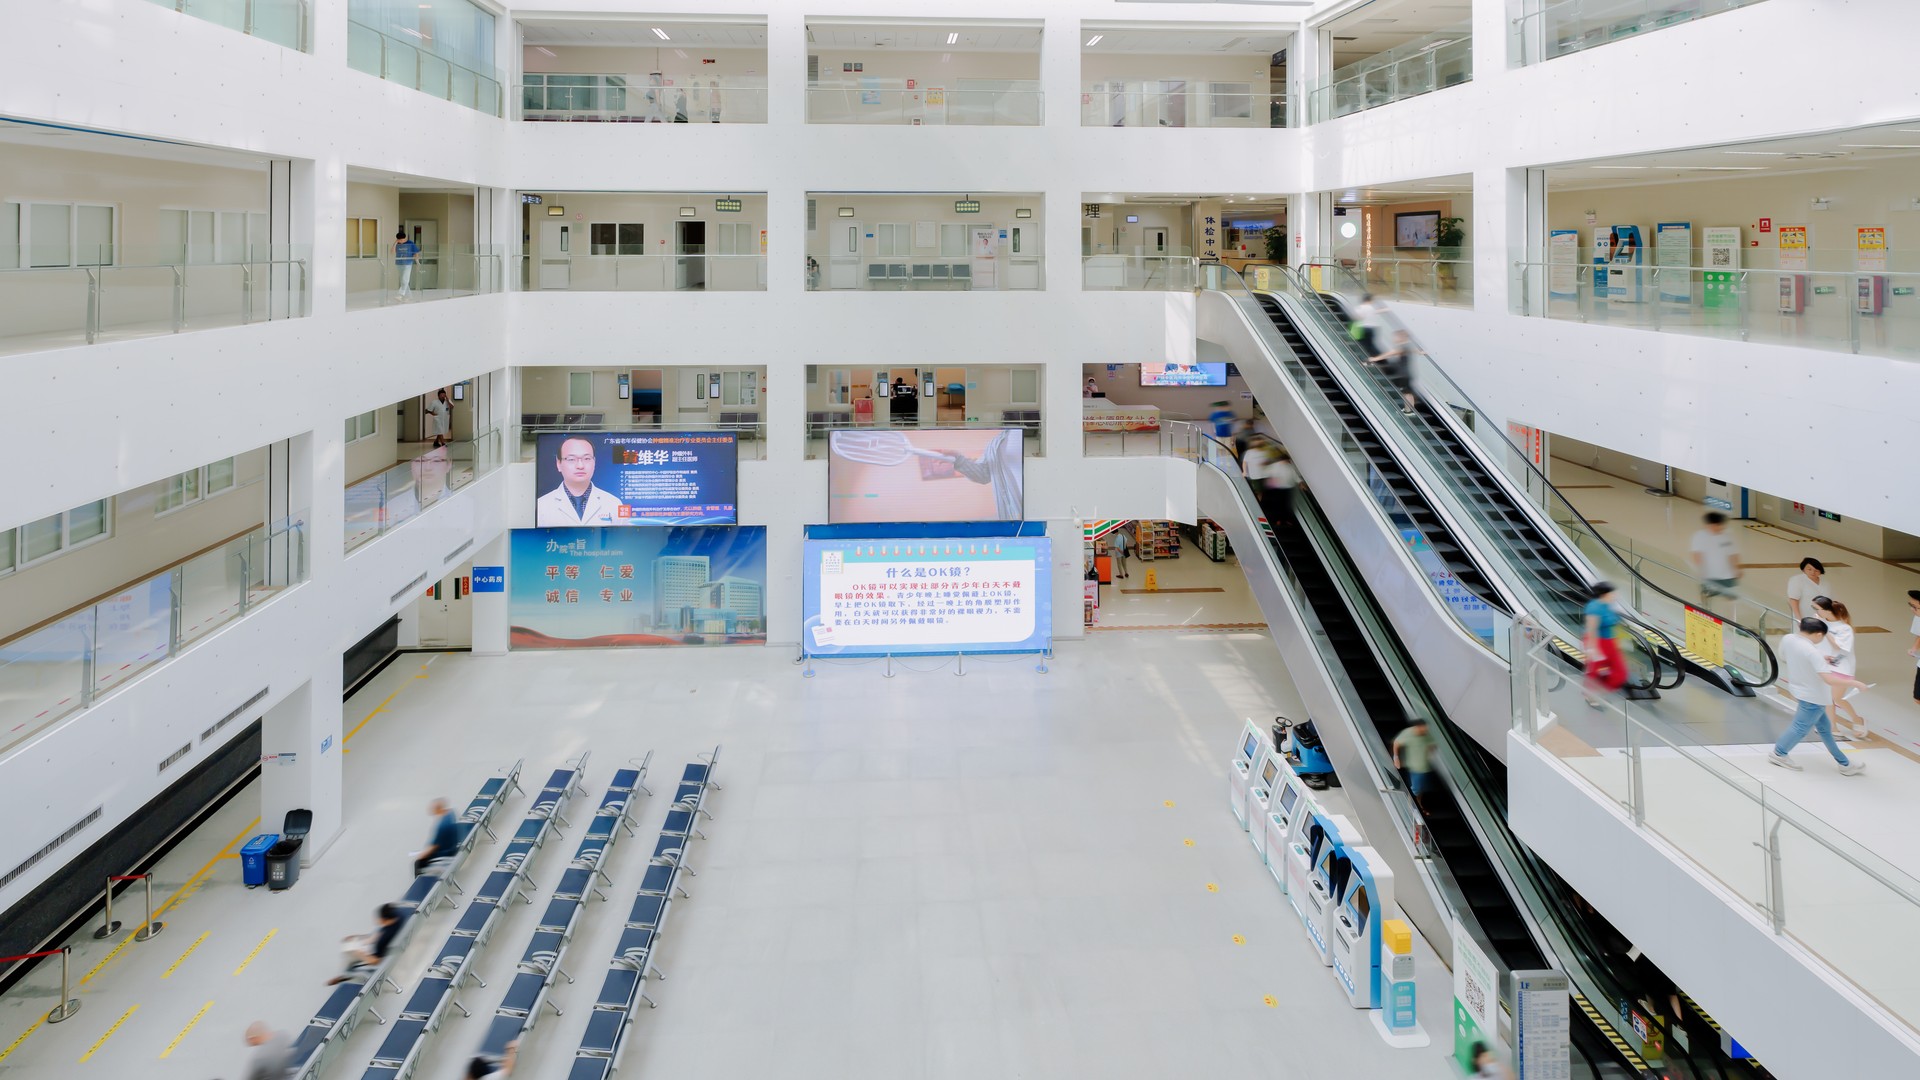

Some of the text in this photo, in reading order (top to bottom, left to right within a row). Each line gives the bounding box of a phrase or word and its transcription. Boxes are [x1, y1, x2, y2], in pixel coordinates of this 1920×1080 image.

[1204, 216, 1216, 257] 体检中心
[546, 538, 587, 554] 办院宗旨
[474, 576, 503, 584] 中心药房
[545, 564, 634, 580] 平等 仁爱
[545, 588, 633, 604] 诚信 专业
[1520, 981, 1530, 990] 1F
